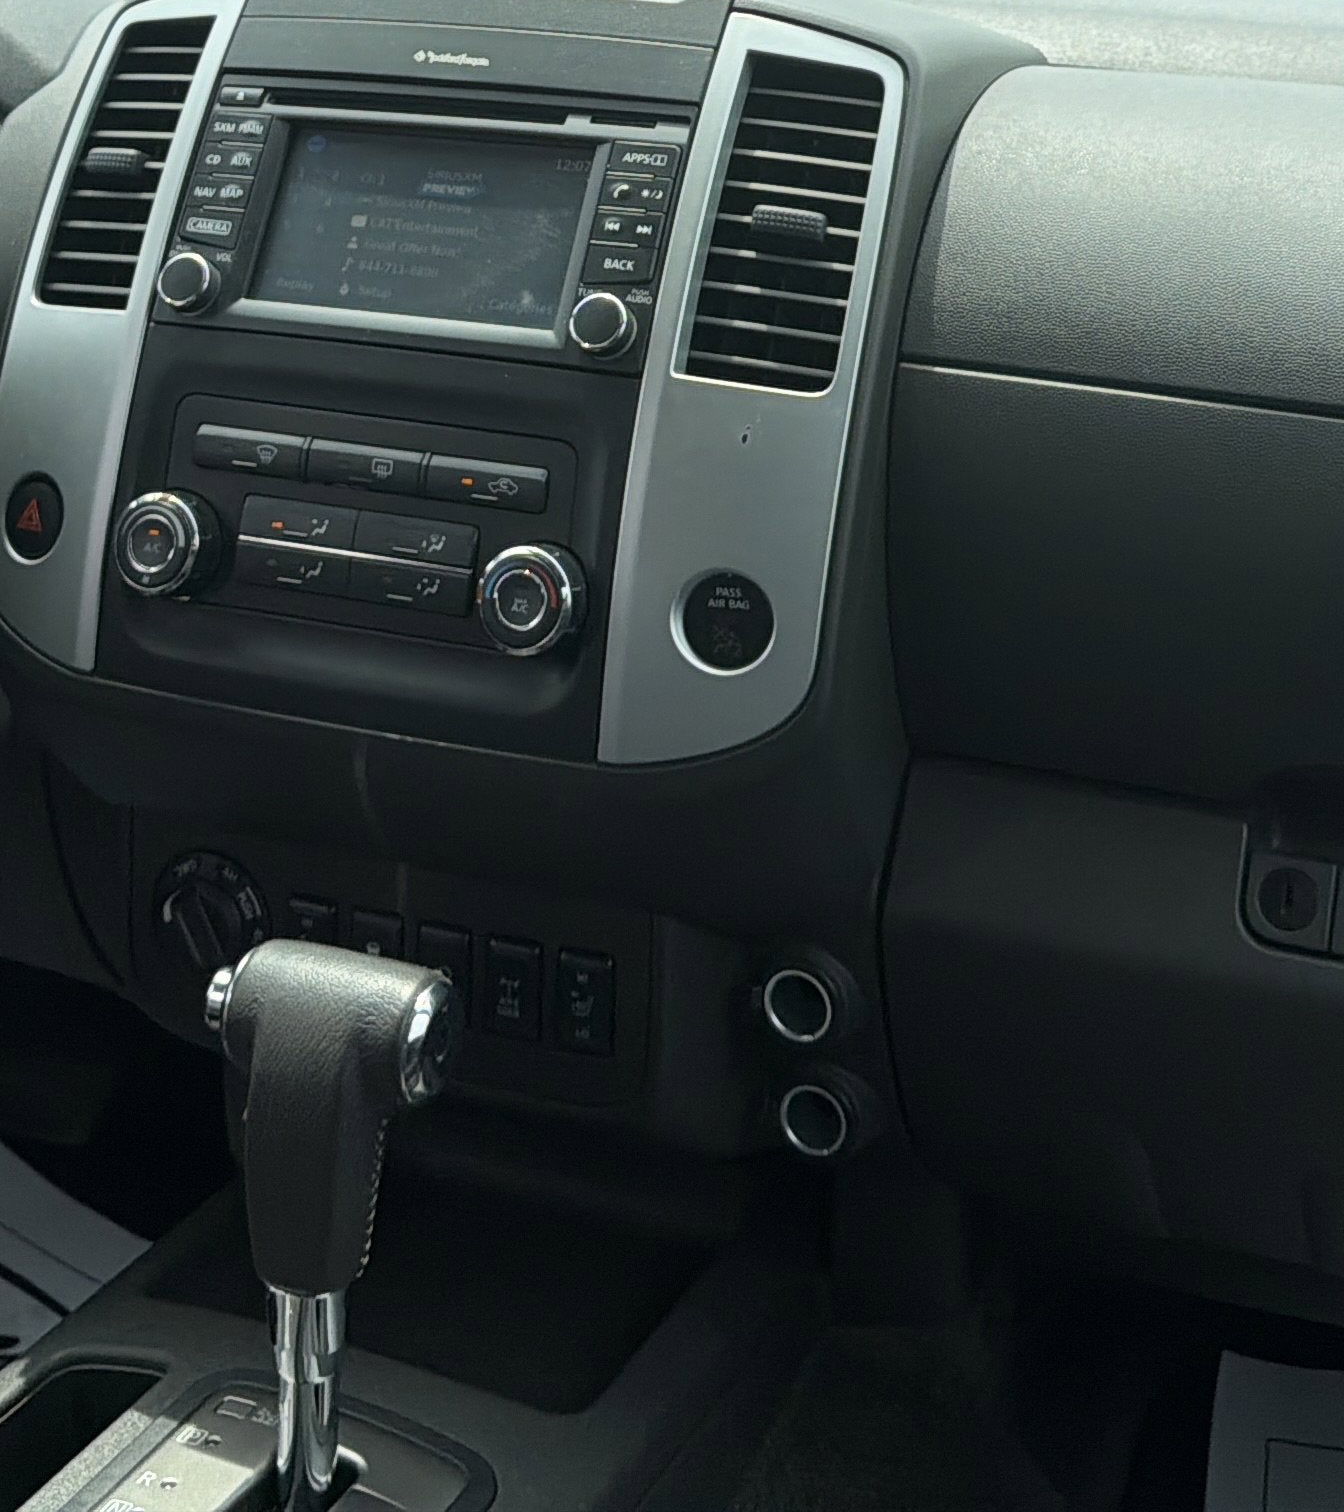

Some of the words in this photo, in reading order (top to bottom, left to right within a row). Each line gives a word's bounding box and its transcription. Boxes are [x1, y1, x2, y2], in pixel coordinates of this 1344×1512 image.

[213, 121, 237, 134] SXM
[205, 153, 222, 166] CD
[230, 153, 253, 168] AUX
[555, 158, 591, 172] 12:07
[194, 186, 217, 198] NAV
[220, 185, 244, 199] MAP
[188, 219, 230, 233] CAMERA
[216, 252, 233, 263] VOL
[603, 257, 635, 271] BACK
[625, 294, 653, 304] AUDIO
[715, 586, 742, 598] PASS
[707, 598, 726, 608] AIR
[728, 599, 750, 610] BAG
[136, 1470, 158, 1487] R
